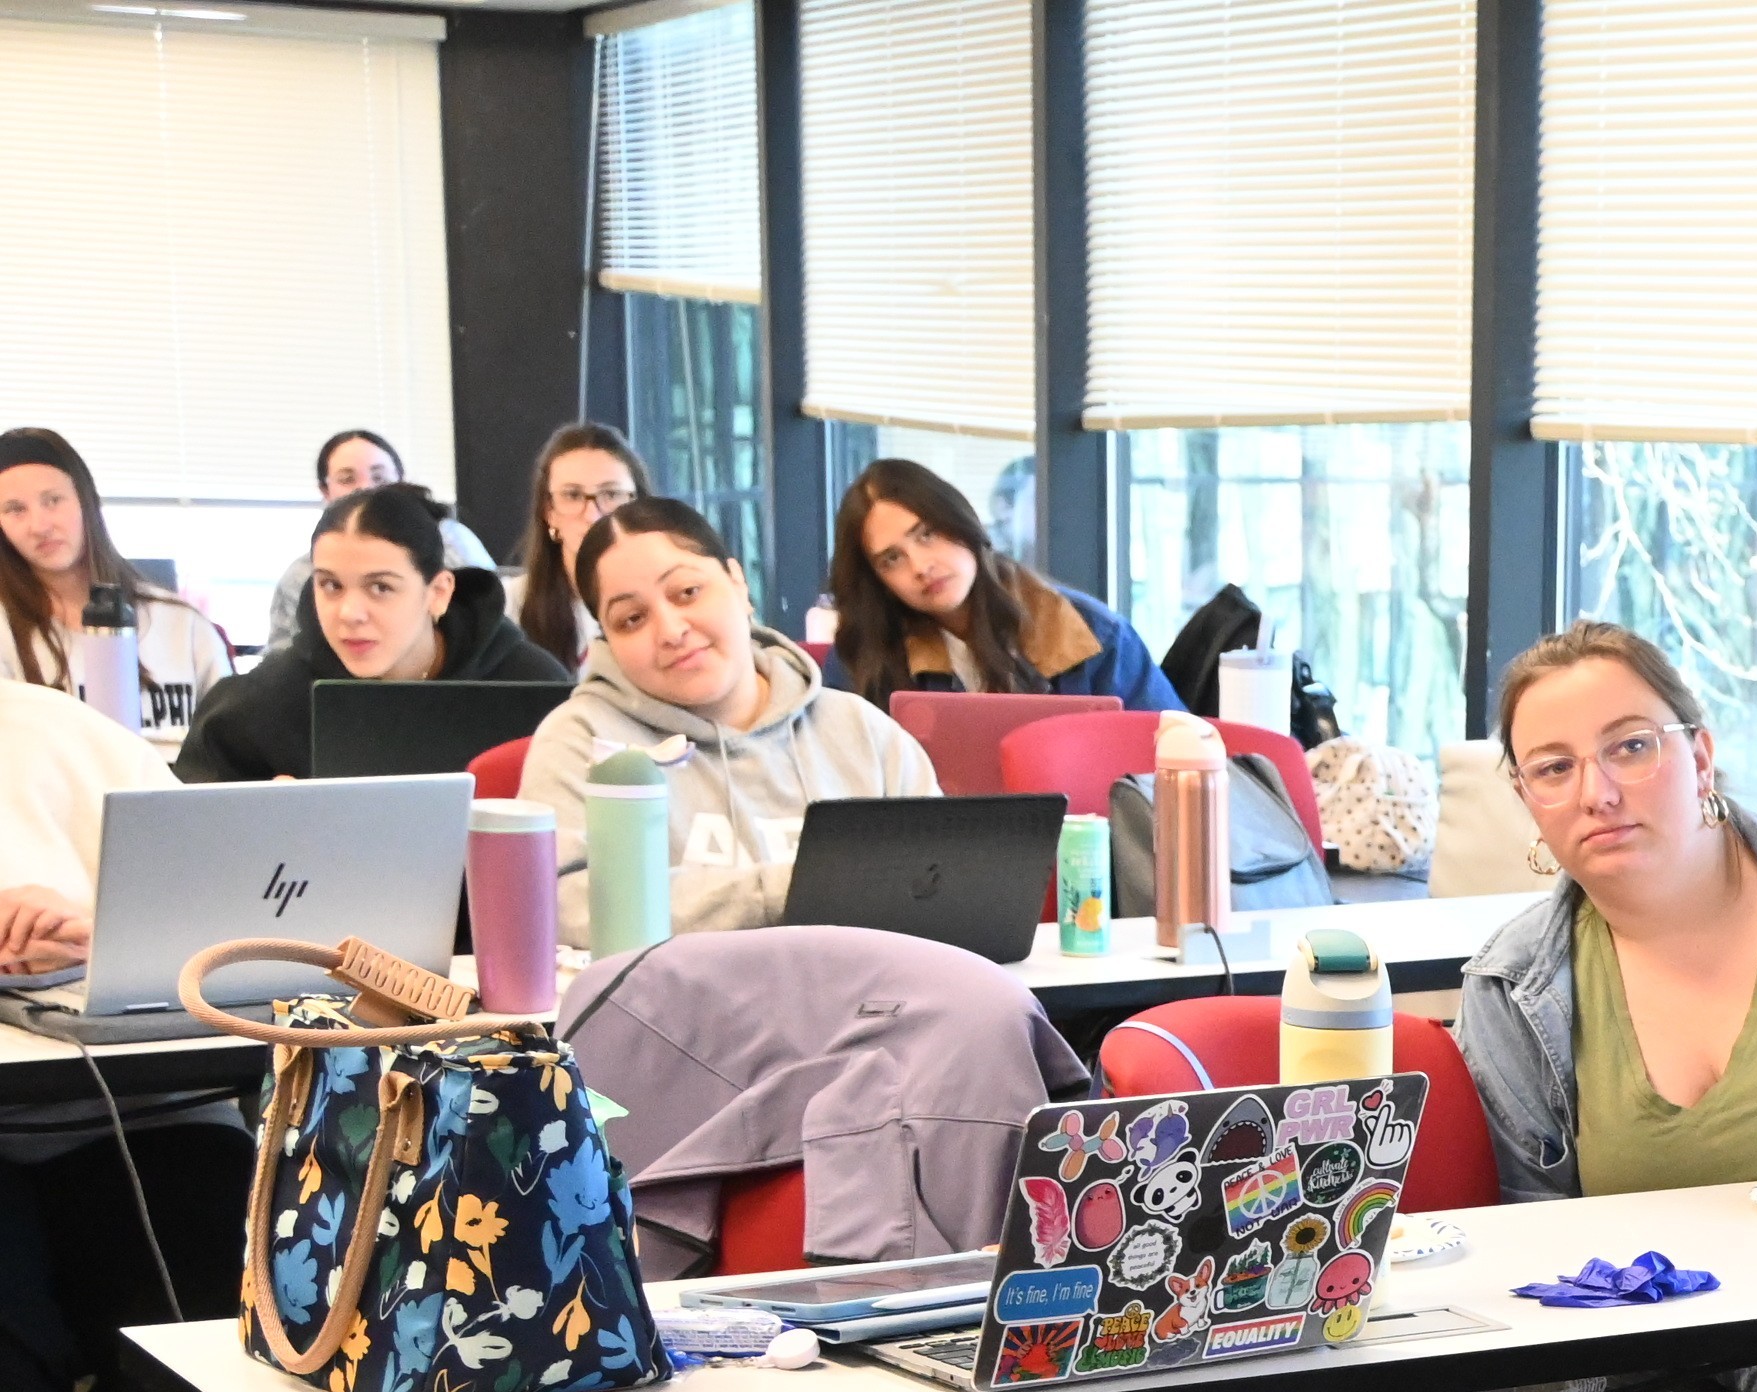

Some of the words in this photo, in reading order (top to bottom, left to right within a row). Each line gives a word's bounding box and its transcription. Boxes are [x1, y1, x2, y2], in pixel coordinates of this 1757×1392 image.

[263, 862, 309, 917] hp
[1286, 1089, 1353, 1118] GRL
[1277, 1115, 1354, 1146] PWR
[1223, 1167, 1253, 1190] PEACE
[1258, 1162, 1265, 1172] &
[1269, 1145, 1293, 1166] LOVE
[1235, 1216, 1263, 1237] NOT
[1271, 1197, 1298, 1217] WAR
[1005, 1287, 1022, 1305] It's
[1026, 1285, 1048, 1304] fine,
[1053, 1283, 1070, 1301] I'm
[1073, 1281, 1093, 1299] fine
[1101, 1312, 1150, 1335] PEACE
[1211, 1321, 1297, 1350] EQUALITY
[1106, 1333, 1145, 1350] LOVE
